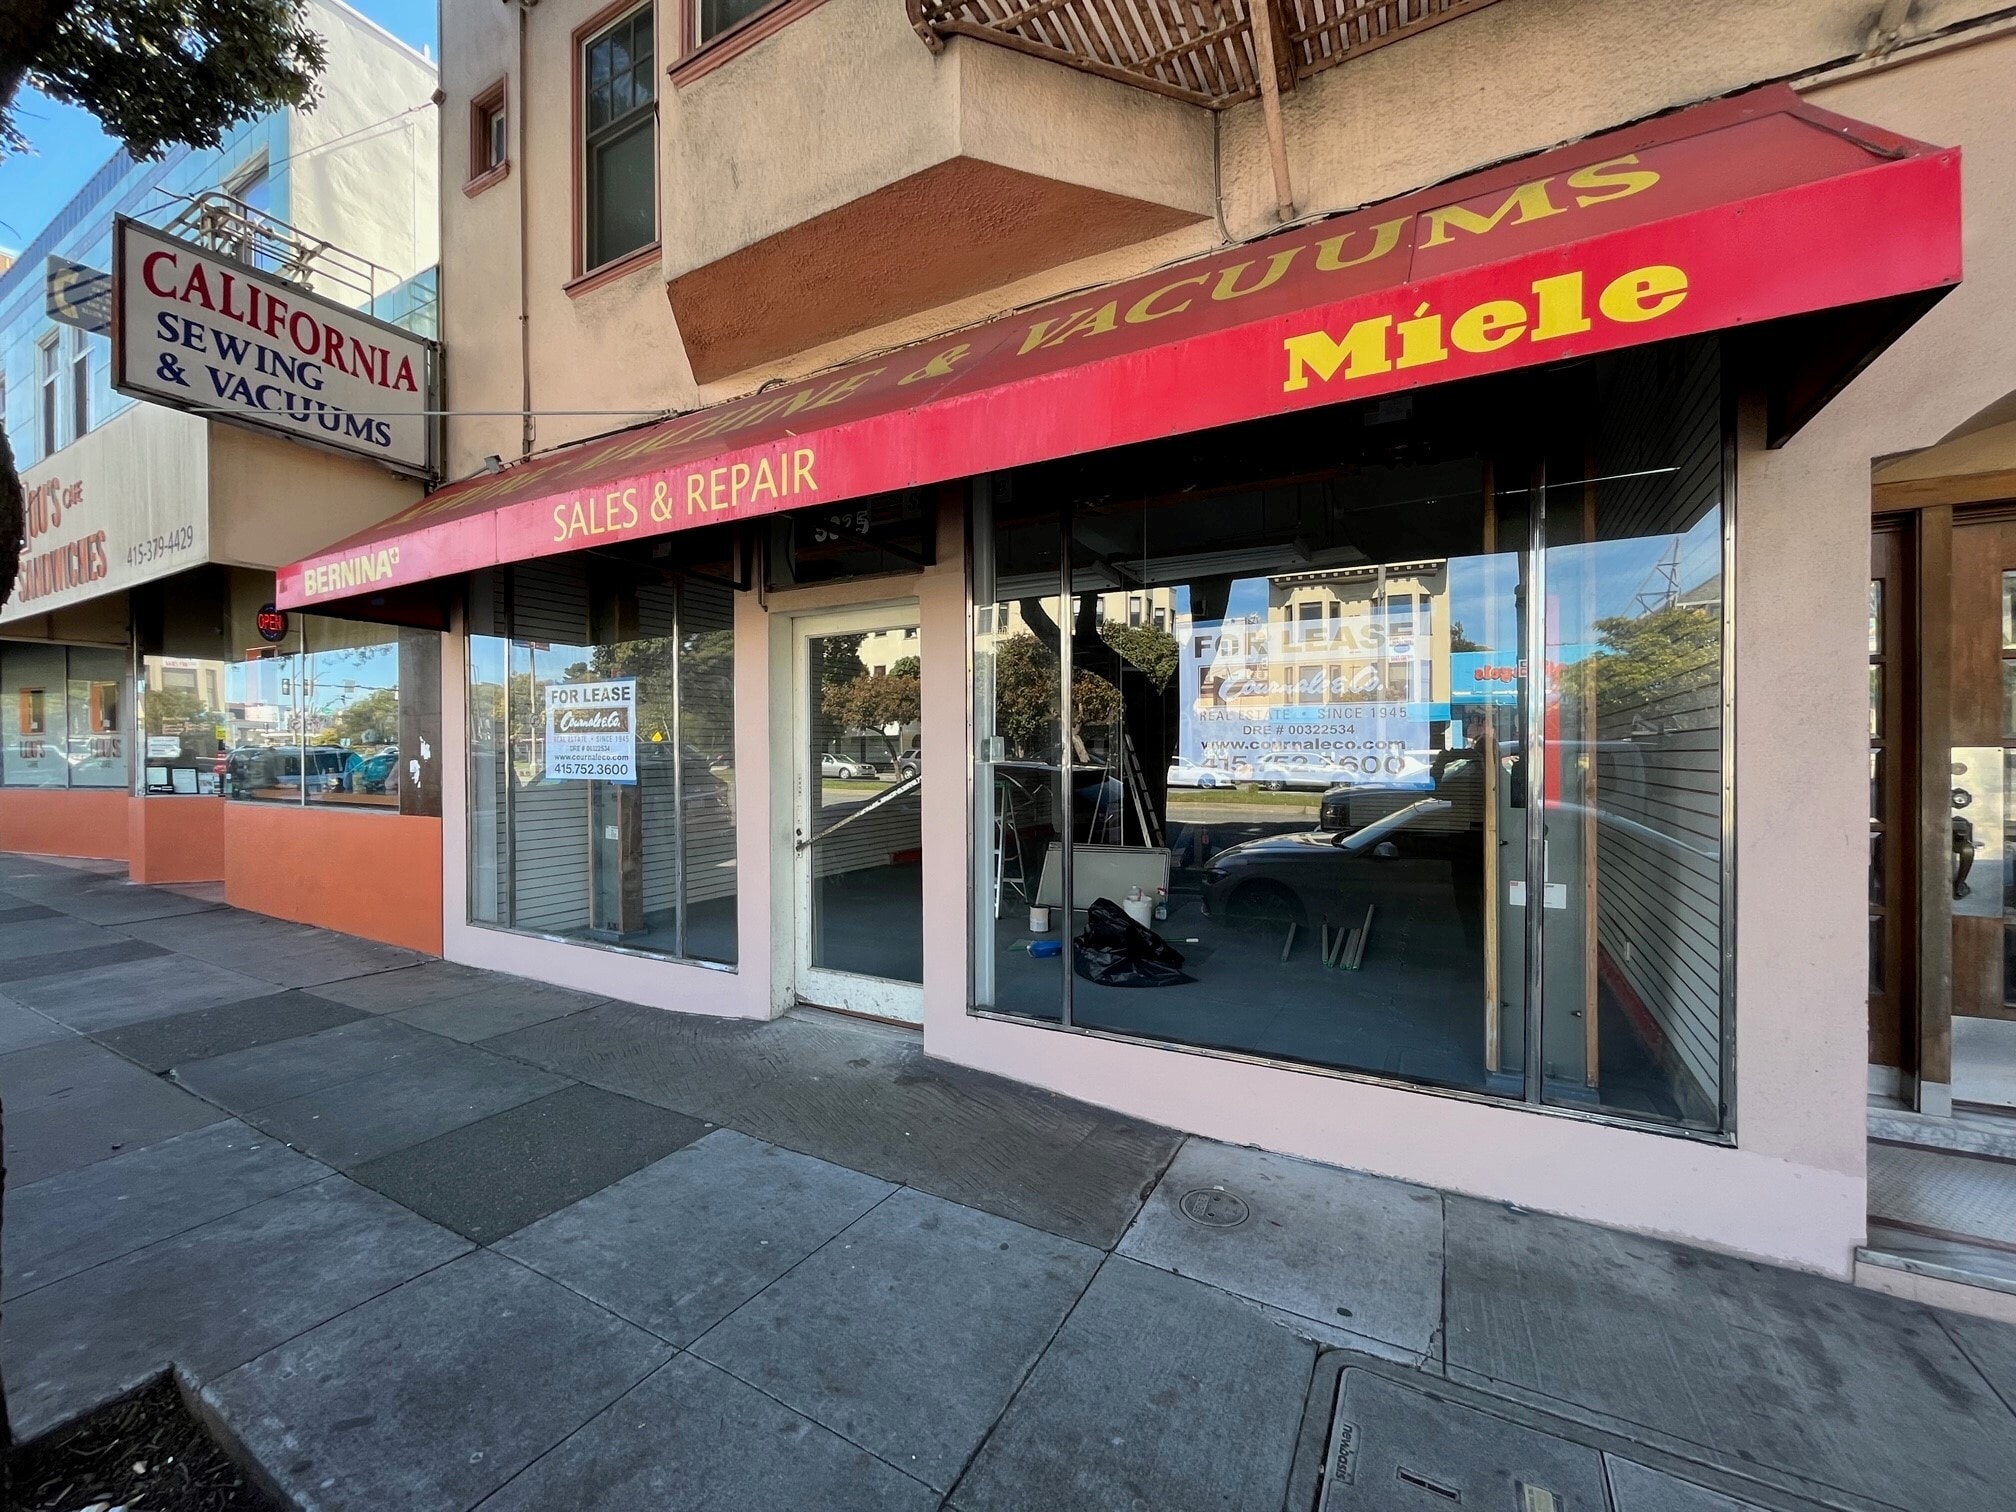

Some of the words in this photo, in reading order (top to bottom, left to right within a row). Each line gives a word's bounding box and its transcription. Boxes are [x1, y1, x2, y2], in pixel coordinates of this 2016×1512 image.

[142, 250, 418, 392] CALIFORNIA
[562, 366, 888, 475] MACHINE
[898, 344, 971, 386] &
[1017, 156, 1662, 357] VACUUMS
[1282, 263, 1690, 393] Miele
[157, 310, 325, 391] SEWING
[156, 351, 191, 388] &
[205, 365, 392, 448] VACUUMS
[28, 477, 62, 539] OU'S
[553, 486, 638, 543] SALES
[650, 481, 674, 523] &
[687, 448, 819, 515] REPAIR
[127, 525, 193, 568] 415-379-4429
[303, 554, 393, 598] BERNINA
[258, 613, 285, 631] OPEN
[1194, 631, 1269, 659] FOR
[1282, 621, 1415, 655] LEASE
[551, 689, 579, 704] FOR
[584, 686, 631, 703] LEASE
[1200, 709, 1233, 722] REAL
[1238, 709, 1291, 721] ESTATE
[1318, 707, 1363, 720] SINCE
[1371, 706, 1408, 719] 1945
[596, 735, 613, 743] SINCE
[1242, 724, 1272, 736] DRE
[1275, 725, 1285, 736] #
[1288, 723, 1356, 736] 00322534
[554, 763, 629, 776] 415.752.3600
[1335, 1423, 1354, 1481] newbasis
